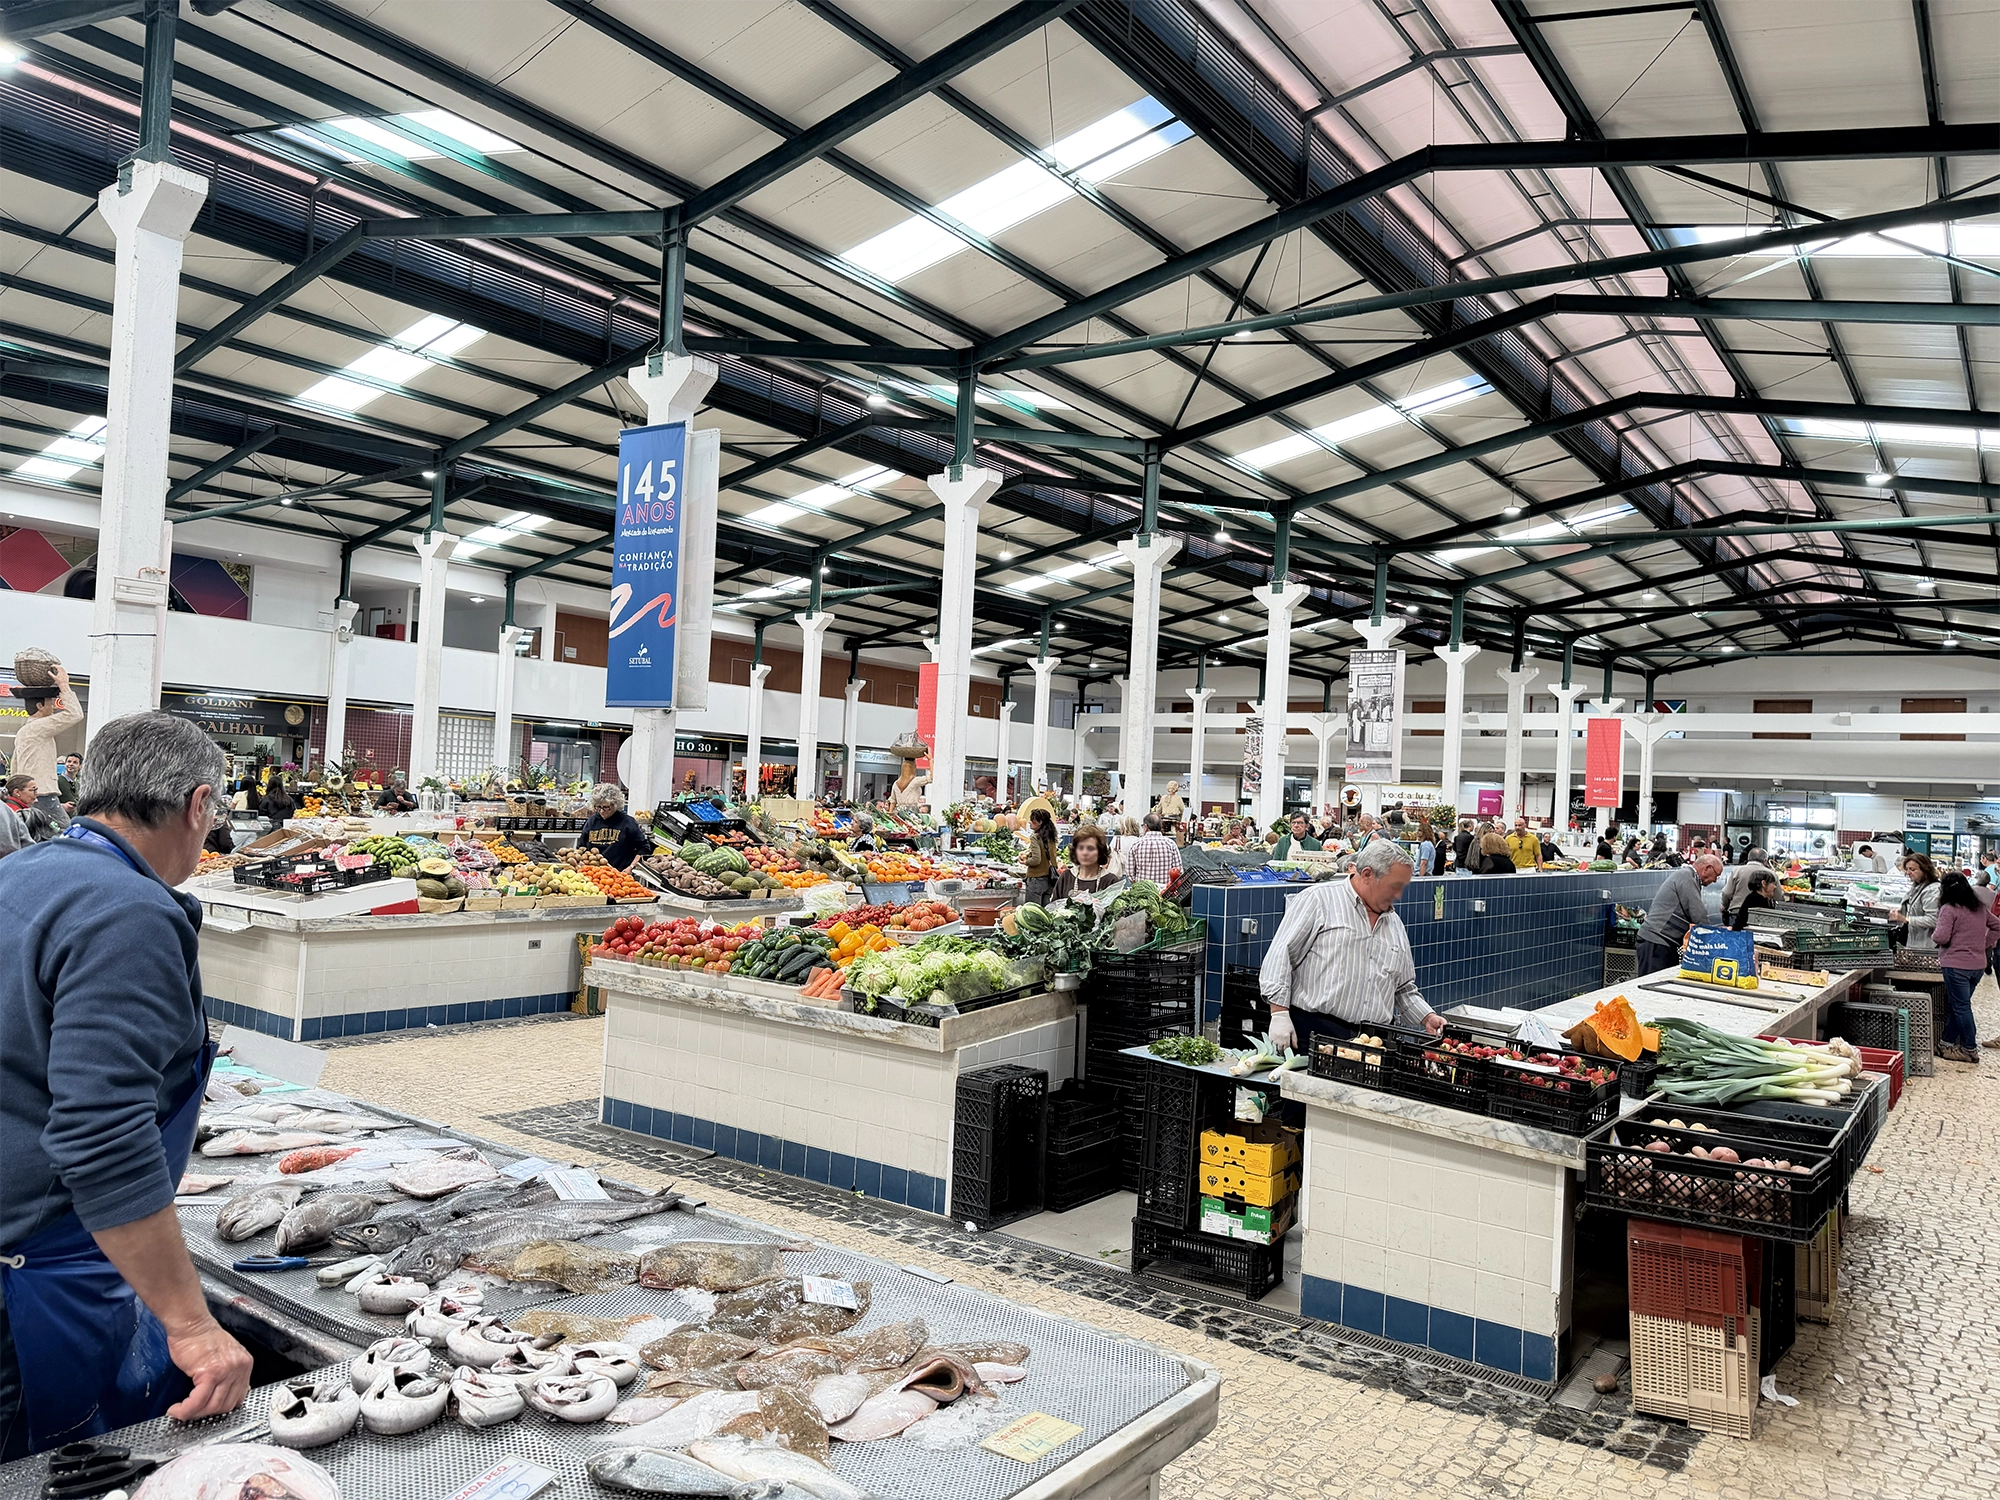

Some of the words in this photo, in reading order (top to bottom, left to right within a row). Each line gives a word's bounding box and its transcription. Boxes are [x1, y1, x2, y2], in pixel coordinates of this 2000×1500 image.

[622, 459, 676, 505] 145
[621, 500, 676, 526] ANOS
[619, 550, 673, 562] CONFIANÇA
[627, 560, 673, 572] TRADIÇÃO
[184, 696, 254, 709] GOLDANI
[698, 743, 712, 752] 30
